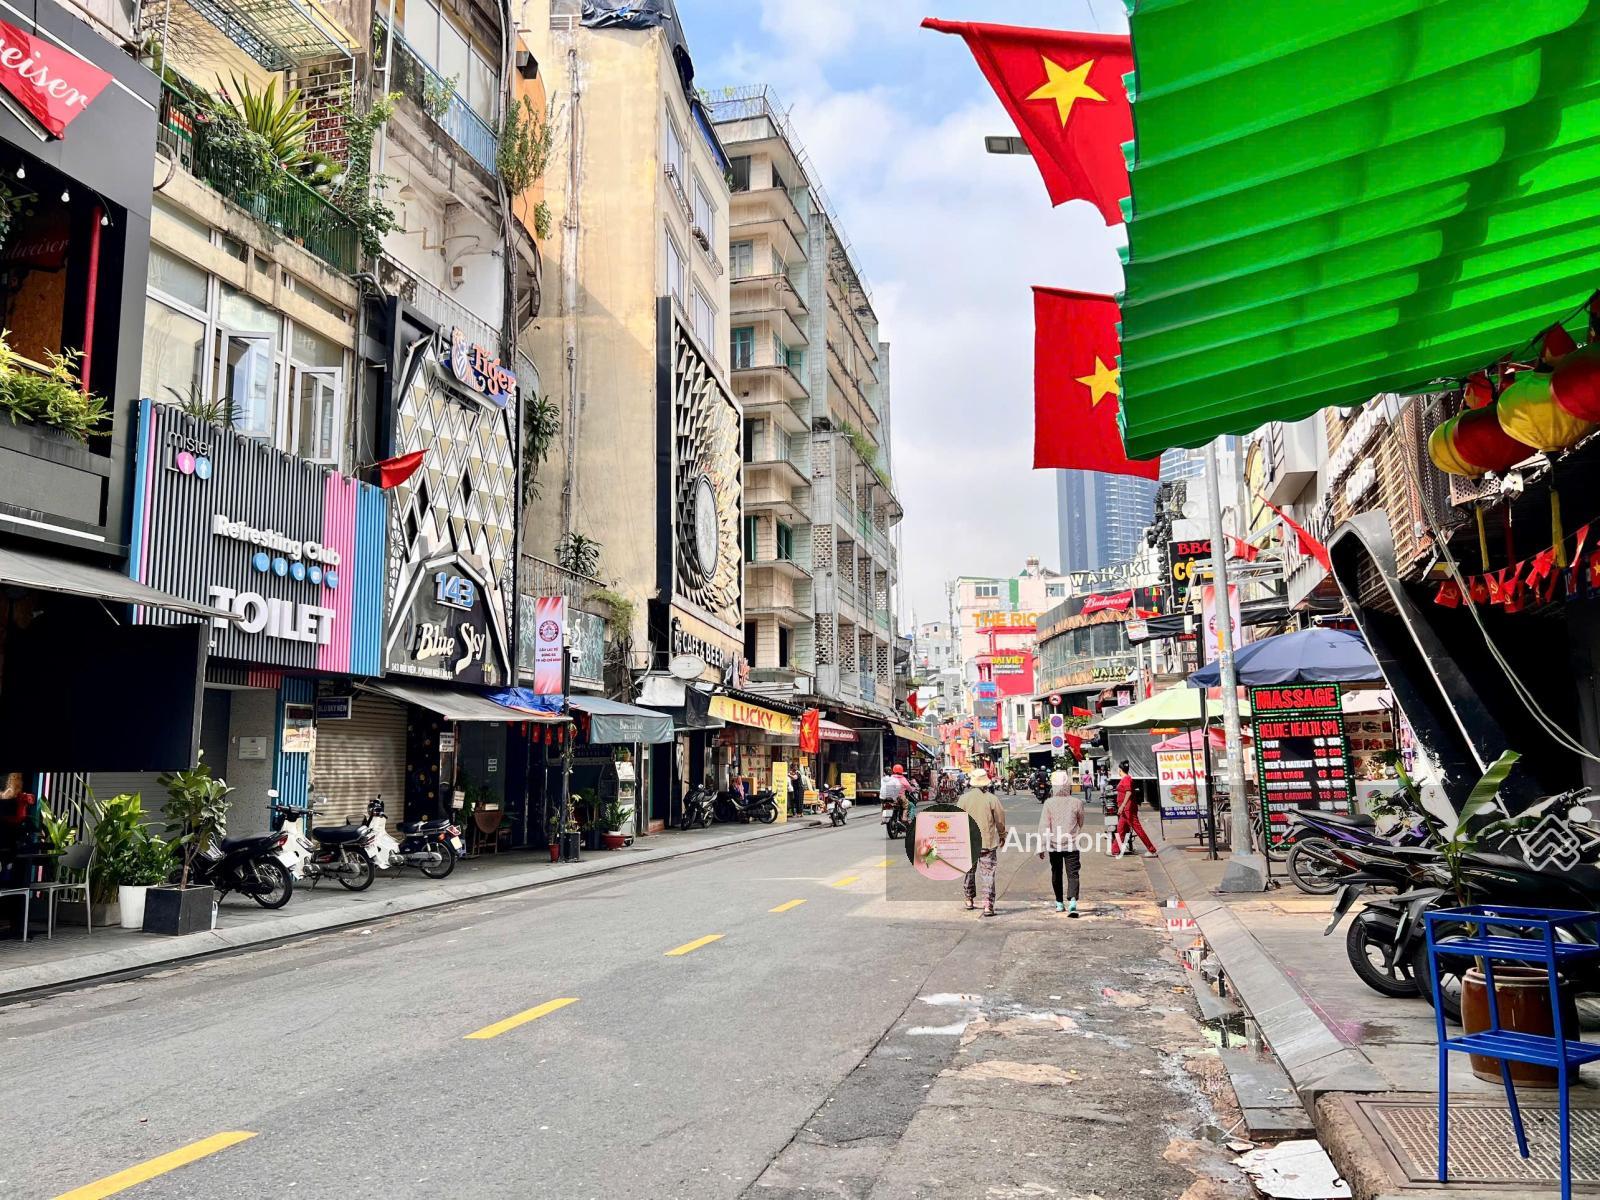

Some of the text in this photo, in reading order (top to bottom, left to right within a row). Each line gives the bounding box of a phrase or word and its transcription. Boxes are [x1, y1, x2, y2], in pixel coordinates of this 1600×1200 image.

[0, 38, 88, 109] eiser
[472, 343, 517, 396] Tiger
[167, 431, 213, 457] mister
[213, 514, 341, 566] Refreshing Club
[1070, 560, 1150, 587] WAIKIKI
[435, 571, 475, 608] 143
[1083, 596, 1131, 608] Budweiser
[209, 585, 337, 645] TOILET
[972, 612, 1042, 627] THE RIC
[416, 622, 485, 675] Blue Sky
[682, 631, 700, 658] CAFE
[705, 642, 725, 669] BEER
[1255, 688, 1336, 709] MASSAGE
[732, 703, 773, 729] LUCKY
[1291, 721, 1321, 737] HEALTH
[1321, 720, 1339, 735] SPA
[1262, 740, 1279, 748] FOOT
[1283, 771, 1304, 779] WASH
[1285, 760, 1313, 768] HAIRCUT
